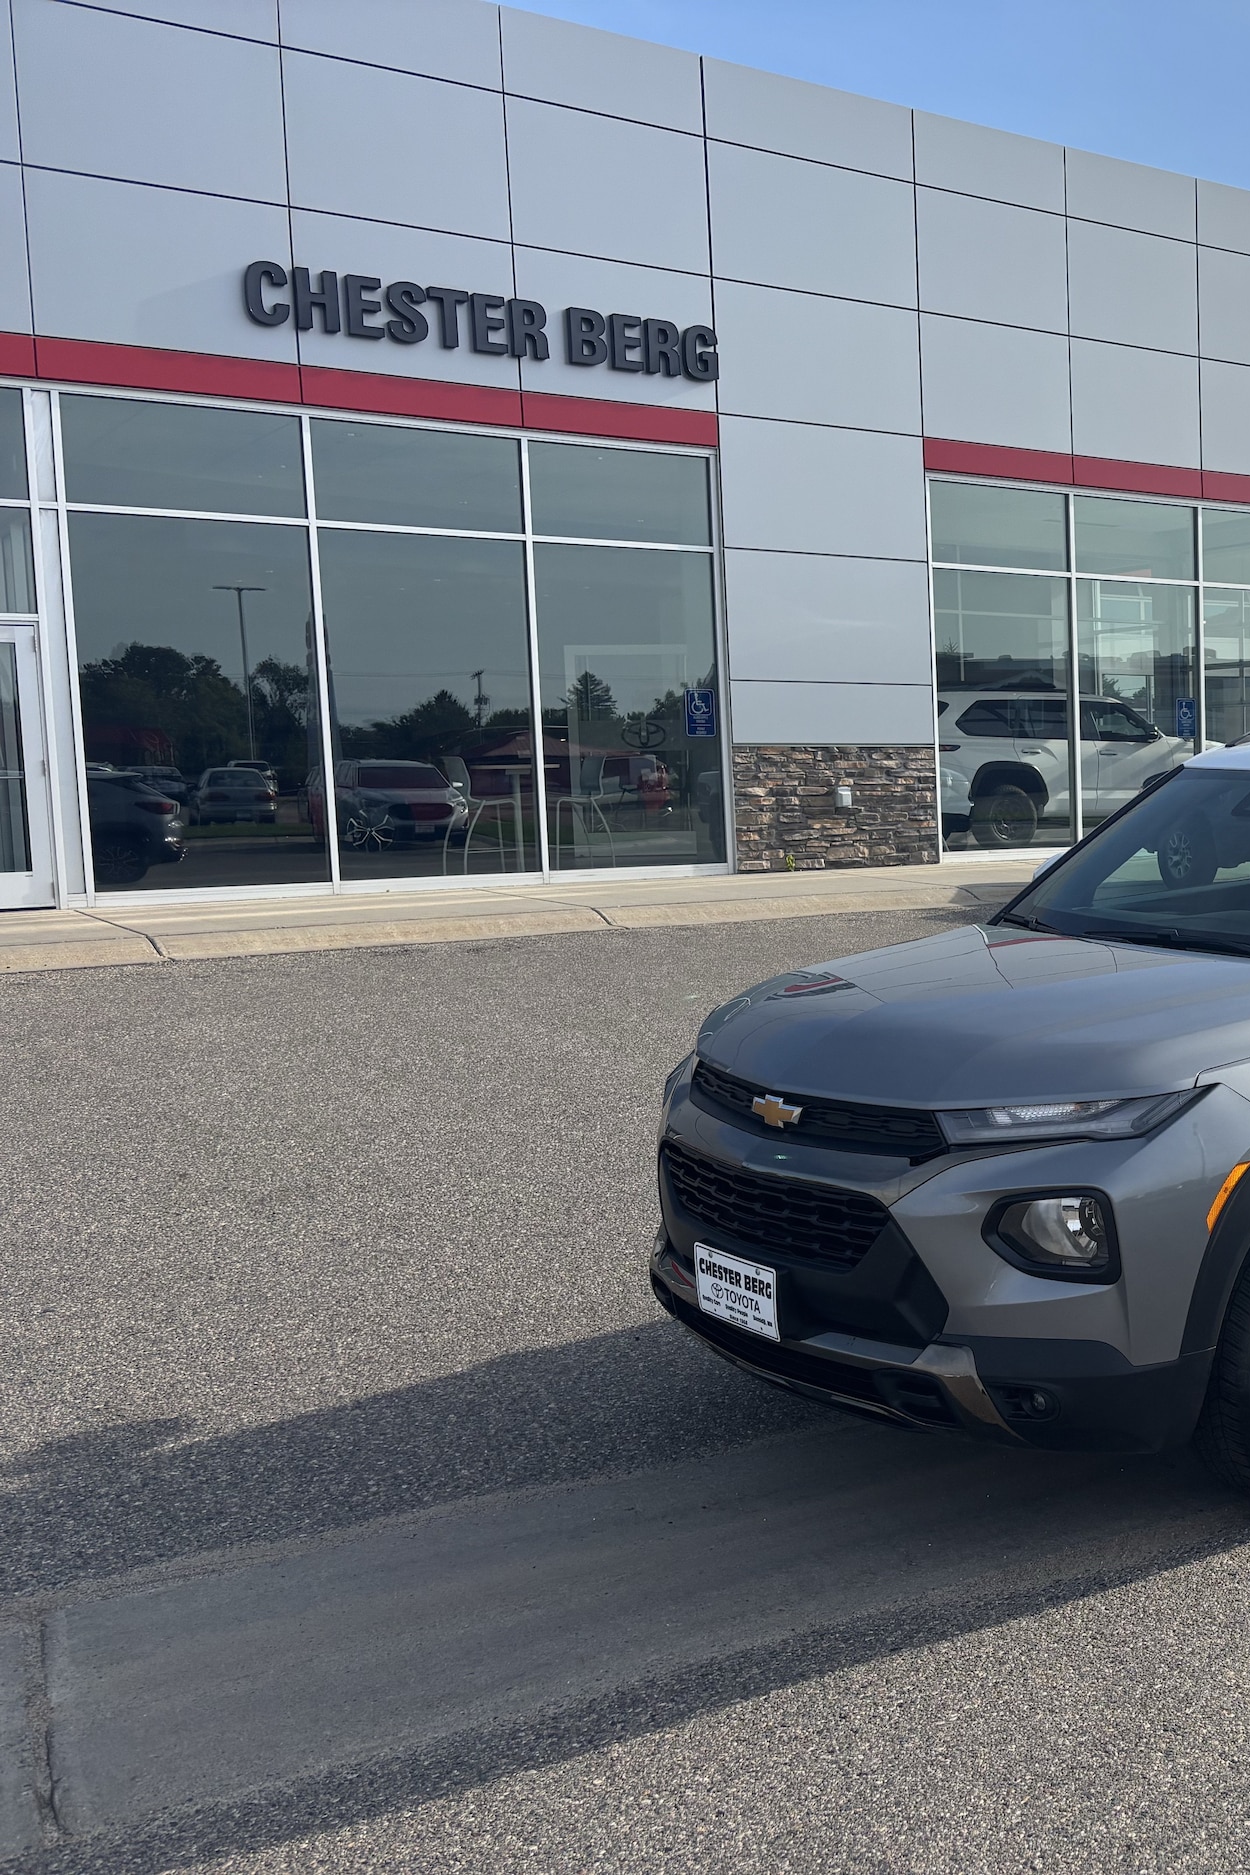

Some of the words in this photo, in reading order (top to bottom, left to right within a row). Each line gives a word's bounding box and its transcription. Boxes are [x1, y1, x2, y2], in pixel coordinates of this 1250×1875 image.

[244, 260, 550, 360] CHESTER
[564, 306, 720, 382] BERG
[699, 1257, 742, 1289] CHESTER
[744, 1274, 772, 1300] BERG
[723, 1287, 761, 1314] TOYOTA
